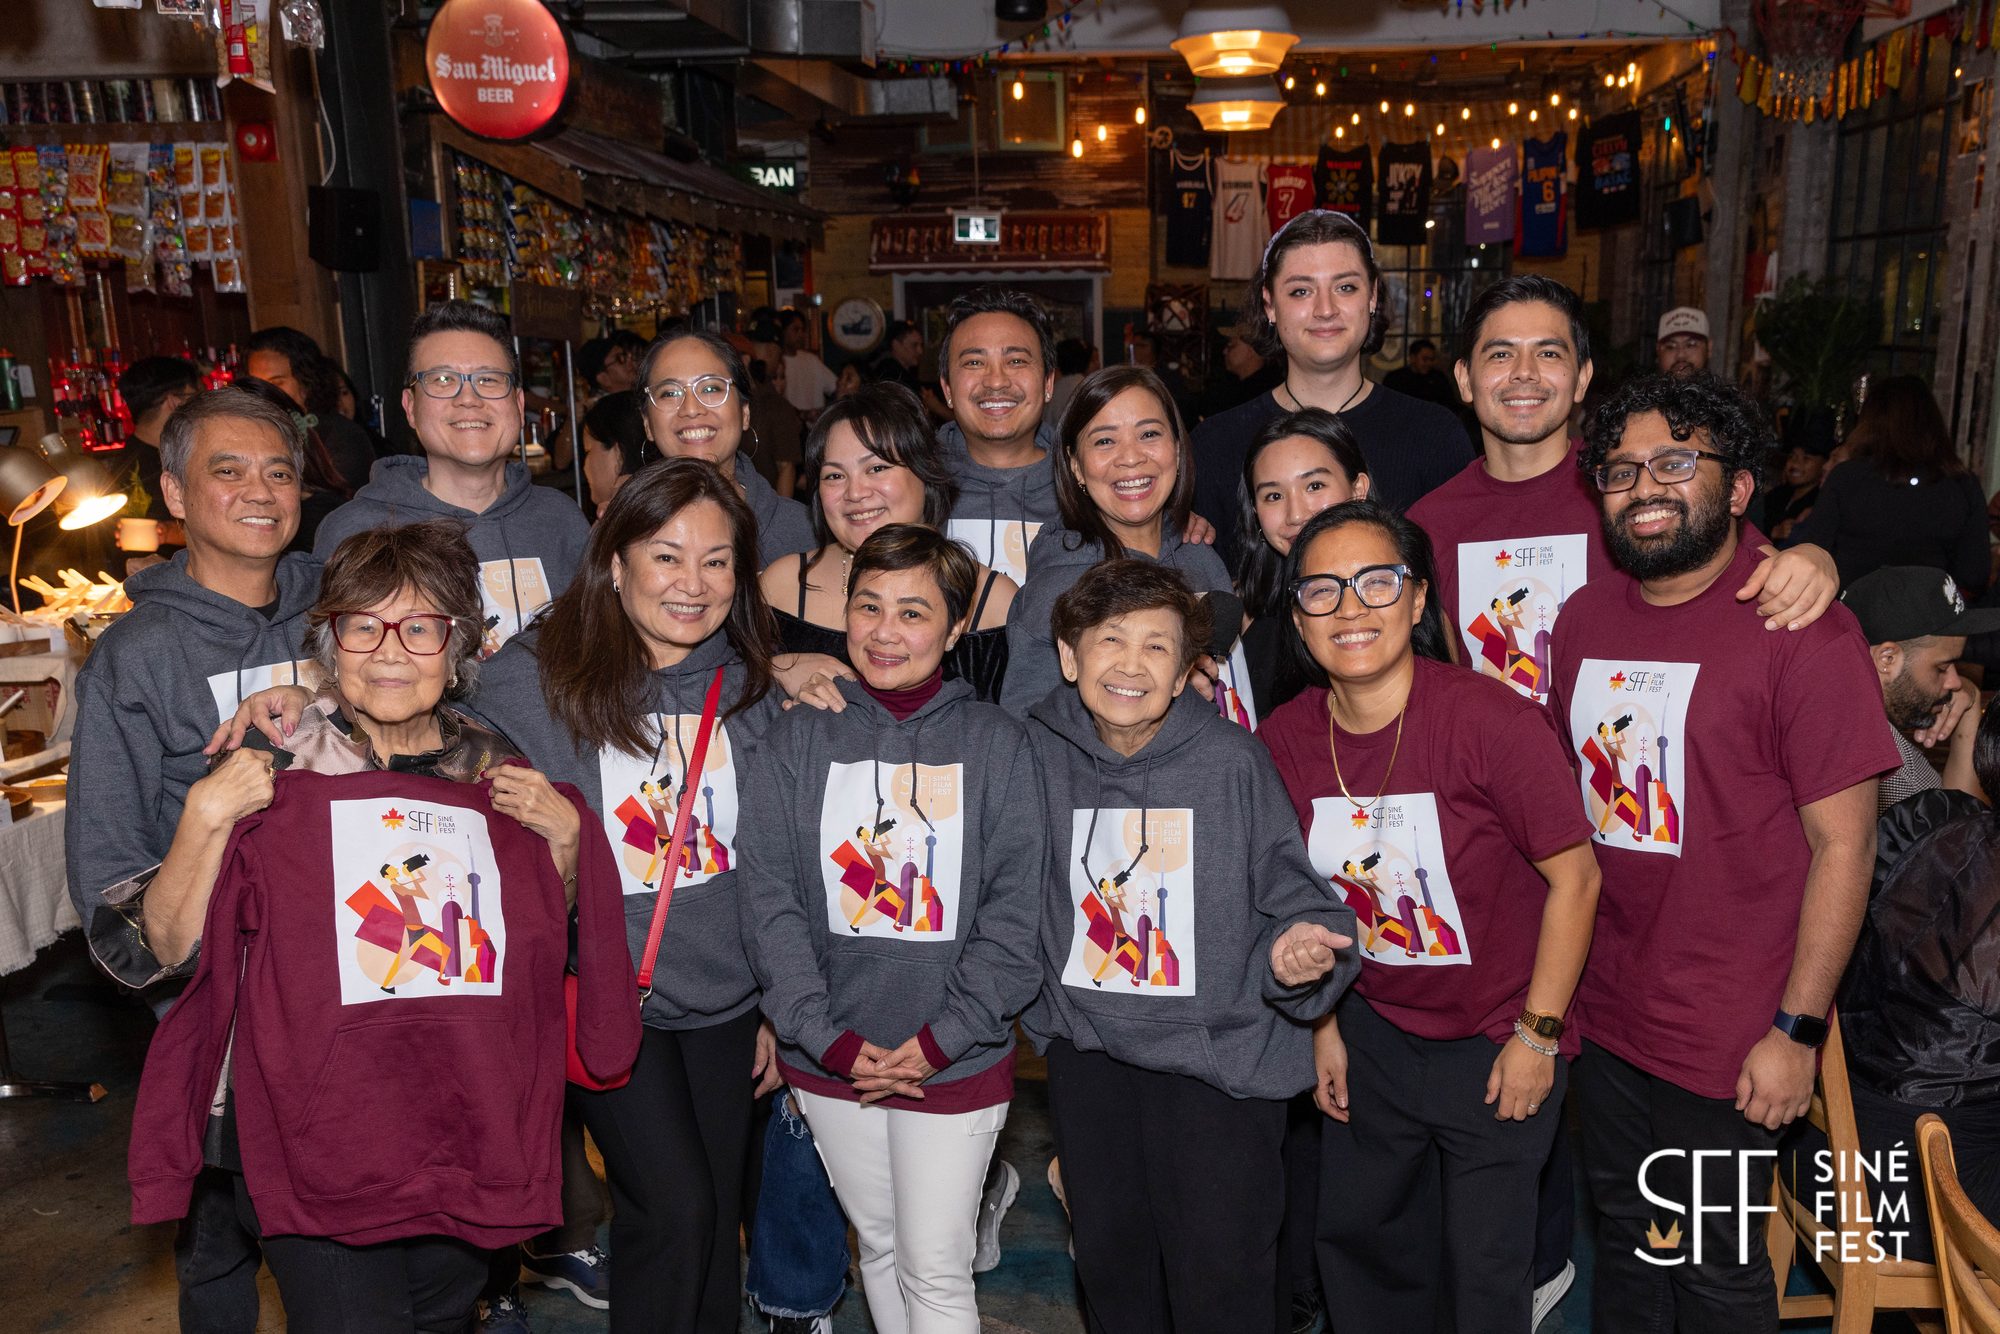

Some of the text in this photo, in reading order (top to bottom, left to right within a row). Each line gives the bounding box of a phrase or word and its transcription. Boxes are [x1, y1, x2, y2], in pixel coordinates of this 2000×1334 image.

[435, 53, 557, 86] San Miguel
[477, 88, 514, 103] BEER
[1542, 181, 1555, 203] 6
[1225, 192, 1250, 223] 4
[1278, 189, 1296, 220] 7
[1514, 547, 1536, 567] SFF
[1625, 671, 1650, 692] SFF
[408, 810, 433, 833] SFF
[1371, 807, 1385, 829] SFF
[1388, 820, 1404, 828] FEST
